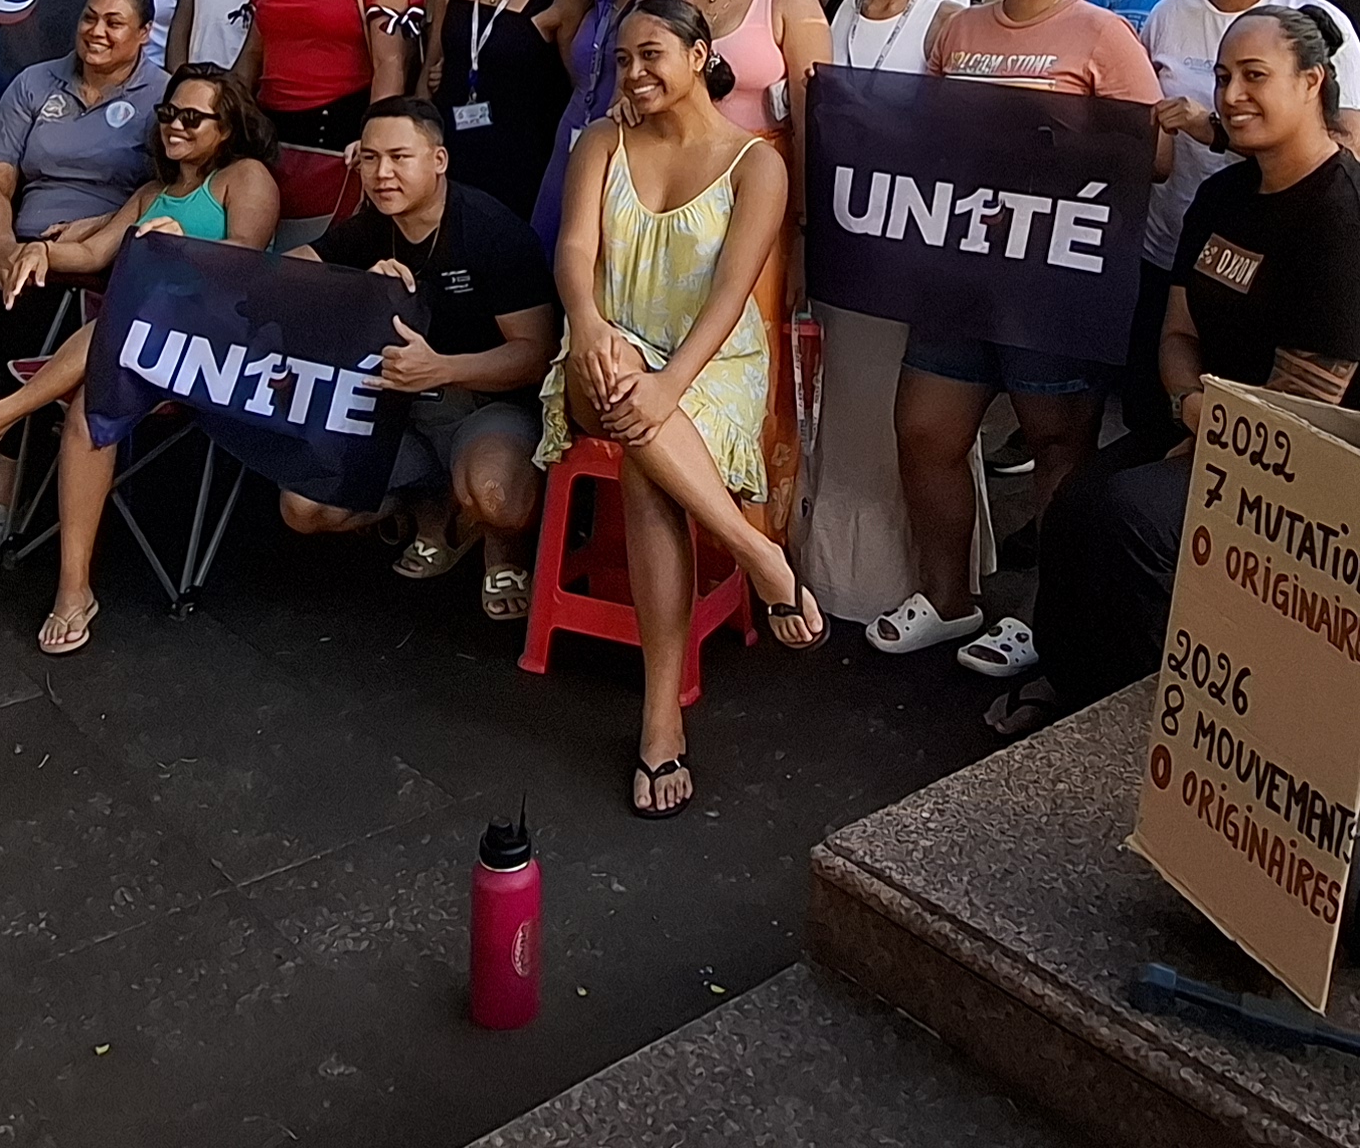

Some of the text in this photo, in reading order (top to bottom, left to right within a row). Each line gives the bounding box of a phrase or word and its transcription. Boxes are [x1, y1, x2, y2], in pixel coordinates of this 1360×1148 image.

[1206, 403, 1295, 483] 2022
[1203, 463, 1228, 509] 7
[1167, 629, 1252, 716] 2026
[1161, 684, 1185, 737] 8
